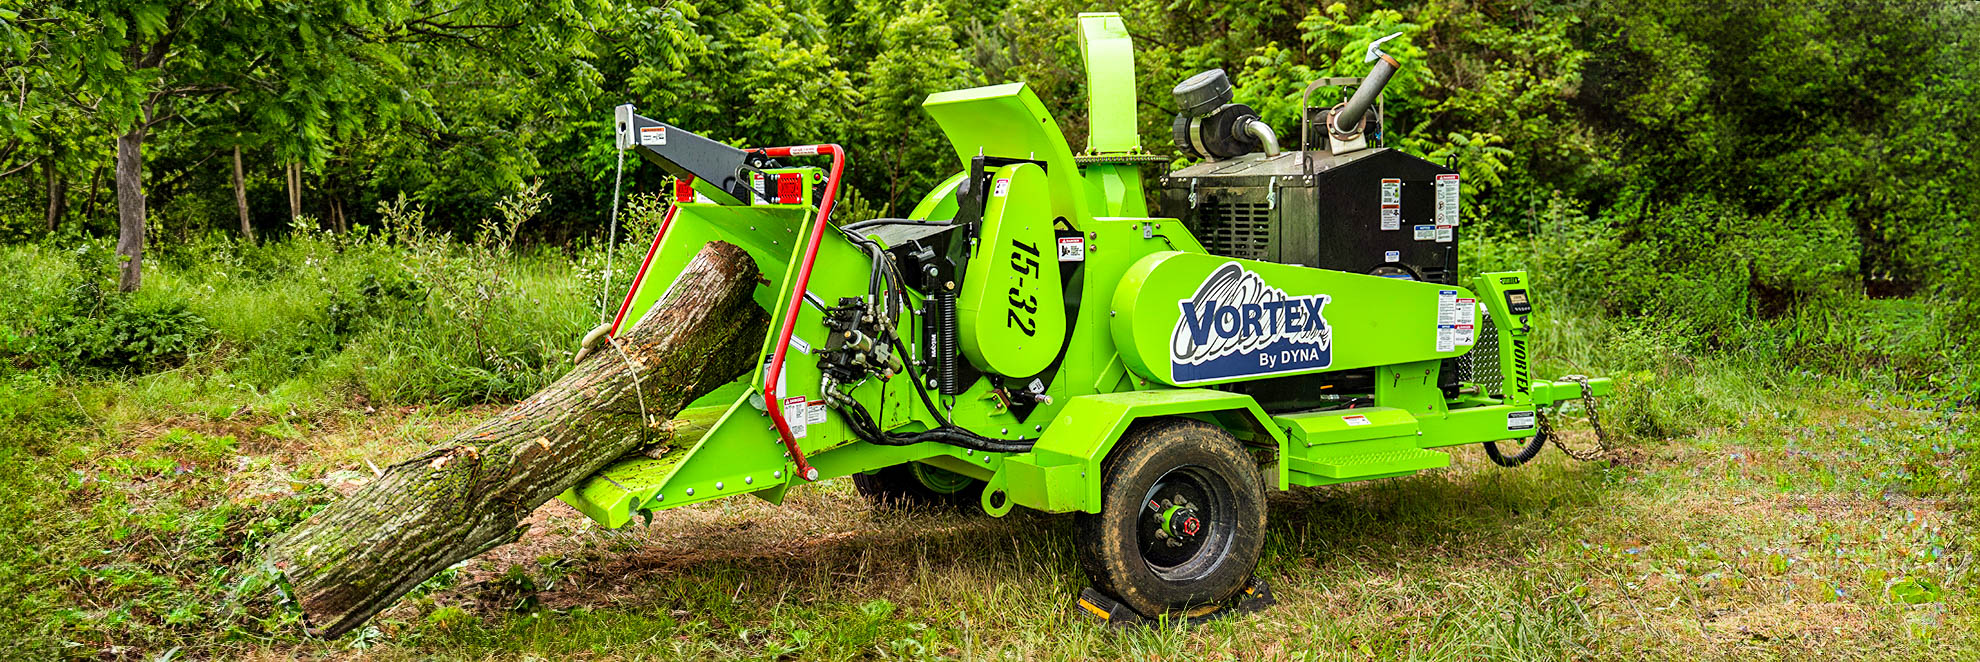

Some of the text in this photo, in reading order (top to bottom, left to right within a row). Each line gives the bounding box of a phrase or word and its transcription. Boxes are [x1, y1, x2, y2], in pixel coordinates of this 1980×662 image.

[1007, 238, 1040, 337] 15-32
[1259, 347, 1320, 369] By DYNA
[1513, 339, 1530, 396] VORTEX
